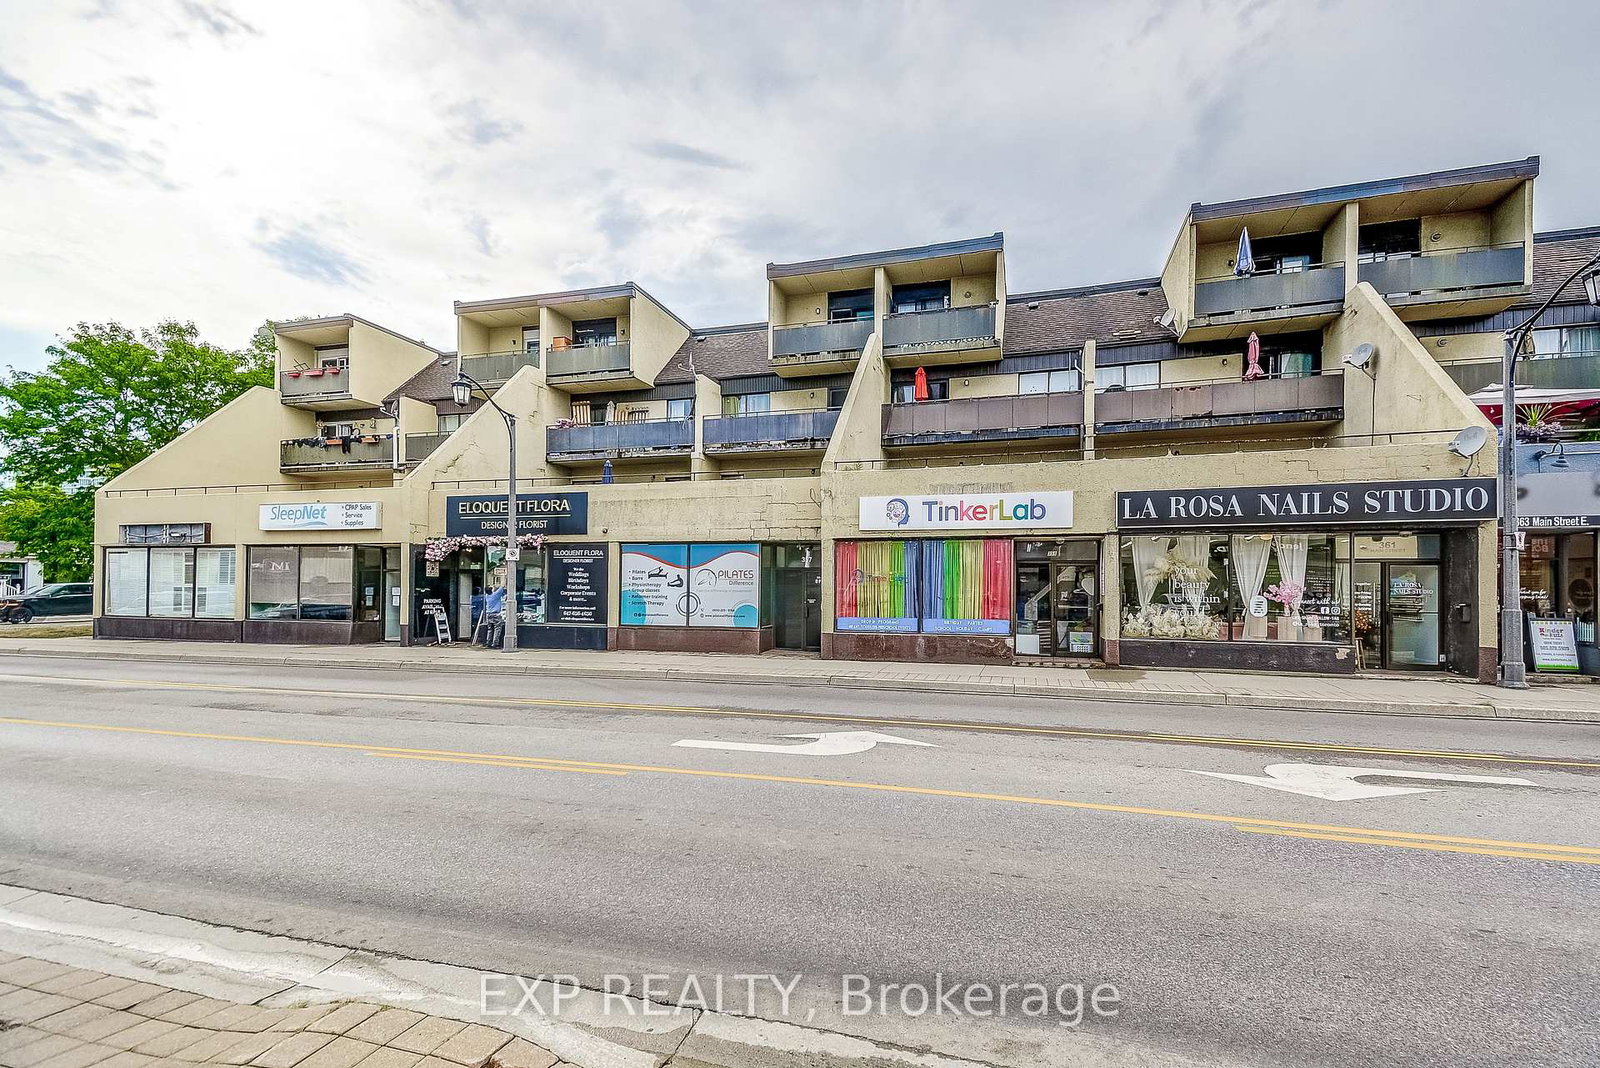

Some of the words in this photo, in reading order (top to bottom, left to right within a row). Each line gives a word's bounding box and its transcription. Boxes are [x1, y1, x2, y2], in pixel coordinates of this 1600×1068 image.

[458, 500, 525, 514] ELOQUET
[526, 499, 571, 512] FLORA
[1122, 497, 1158, 519] LA
[1169, 494, 1244, 518] ROSA
[1257, 491, 1350, 516] NAILS
[1364, 486, 1489, 514] STUDIO
[270, 505, 327, 523] SleepNet
[922, 498, 1046, 521] TinkerLab
[481, 521, 518, 530] DESIGN
[519, 520, 548, 529] FLORIST
[1532, 517, 1552, 526] Main
[1553, 516, 1580, 526] Street
[1580, 516, 1590, 525] E.
[717, 569, 754, 579] PILATES
[1174, 568, 1198, 577] your
[1174, 579, 1211, 591] beauty
[1185, 594, 1221, 603] within
